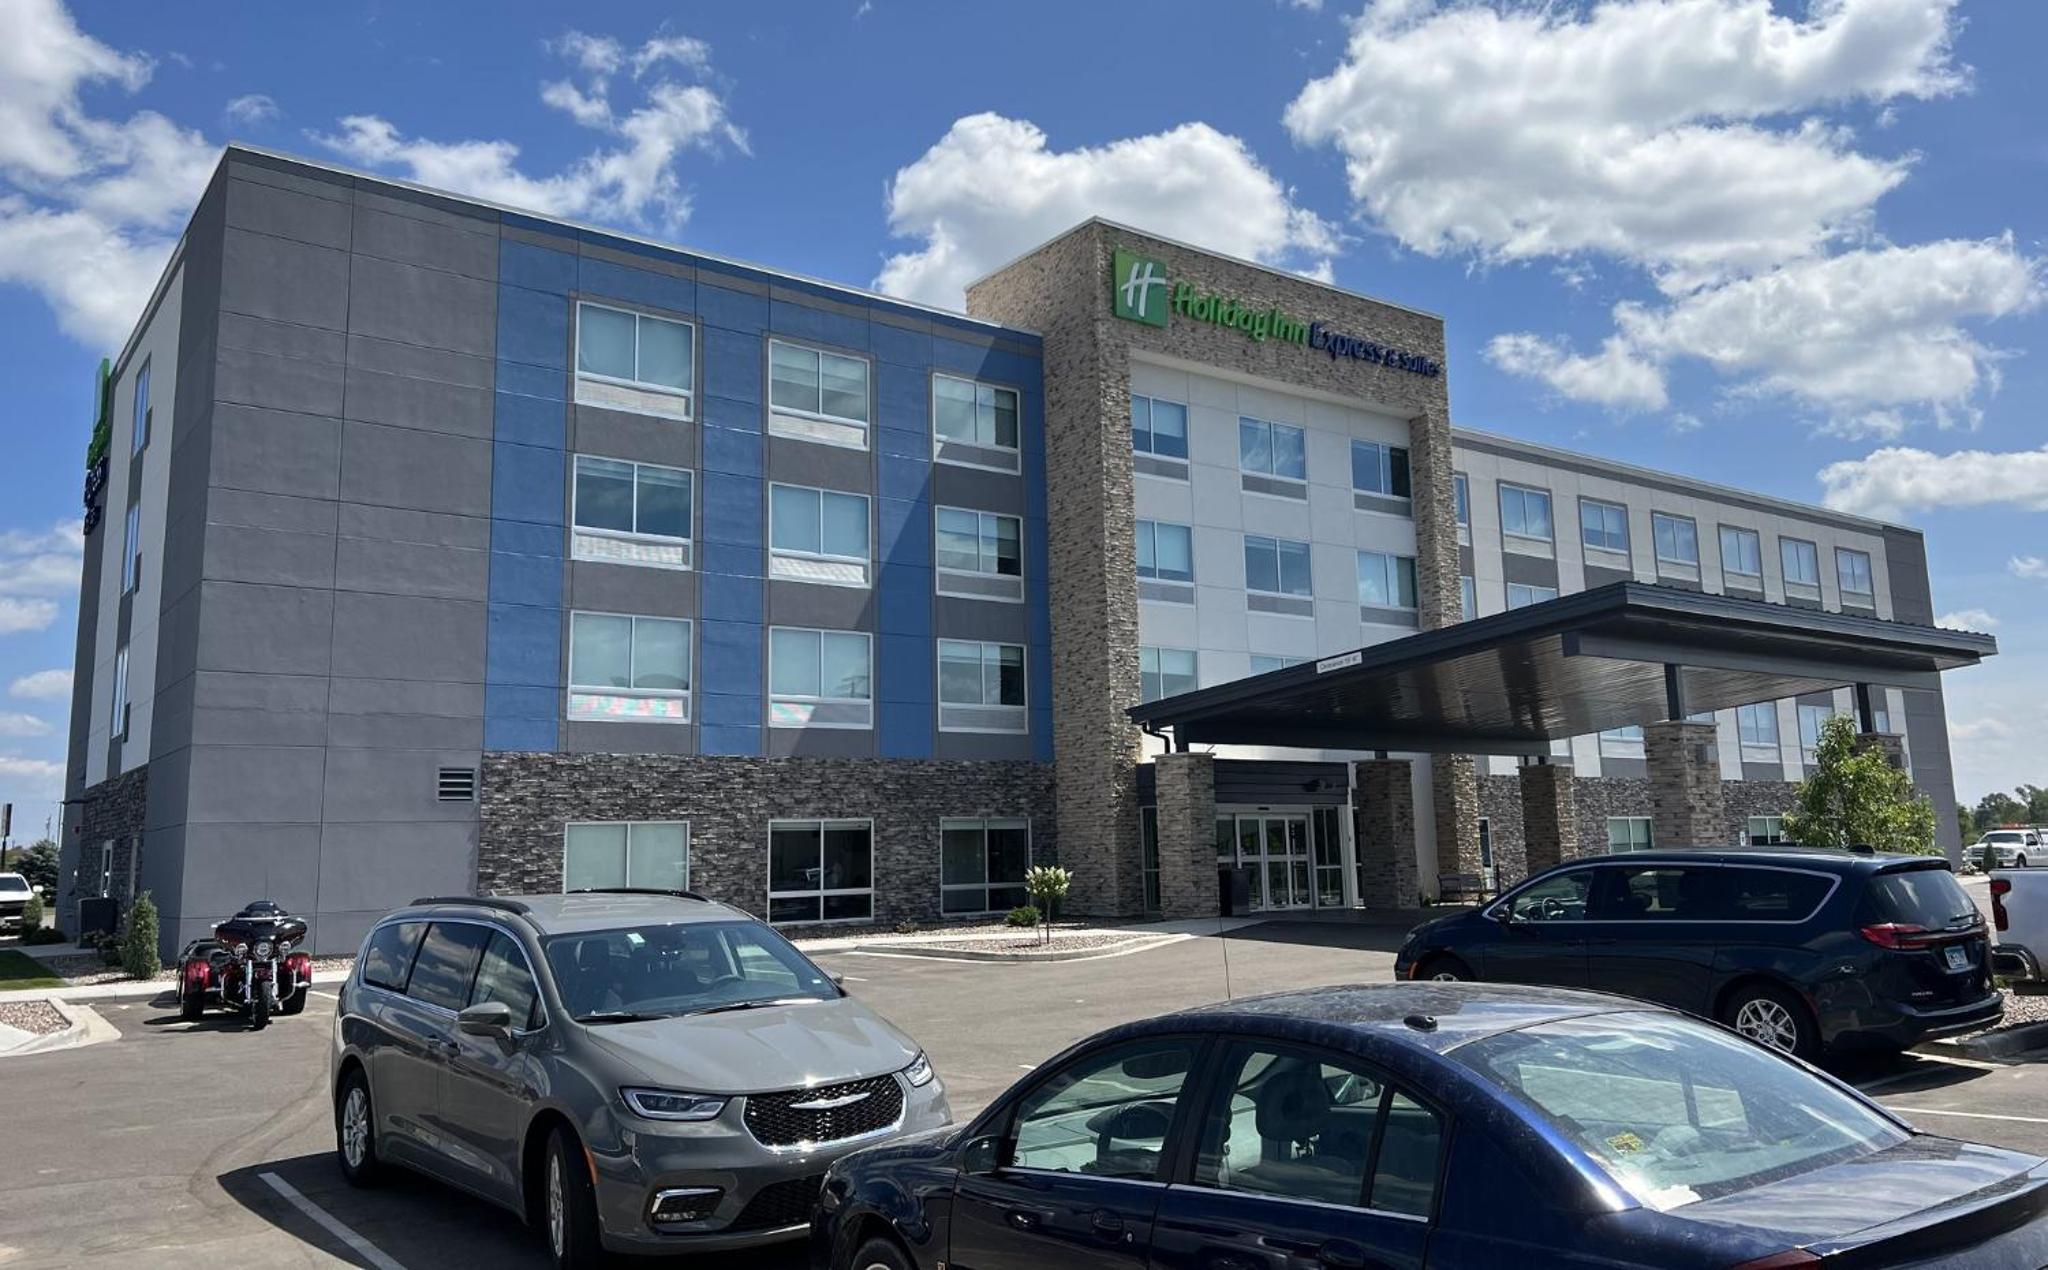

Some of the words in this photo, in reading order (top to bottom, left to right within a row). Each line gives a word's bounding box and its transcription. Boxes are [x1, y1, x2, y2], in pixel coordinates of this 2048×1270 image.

[1121, 262, 1167, 317] H
[1173, 280, 1268, 342] Holiday
[1270, 307, 1307, 344] Inn
[1309, 321, 1381, 363] Express
